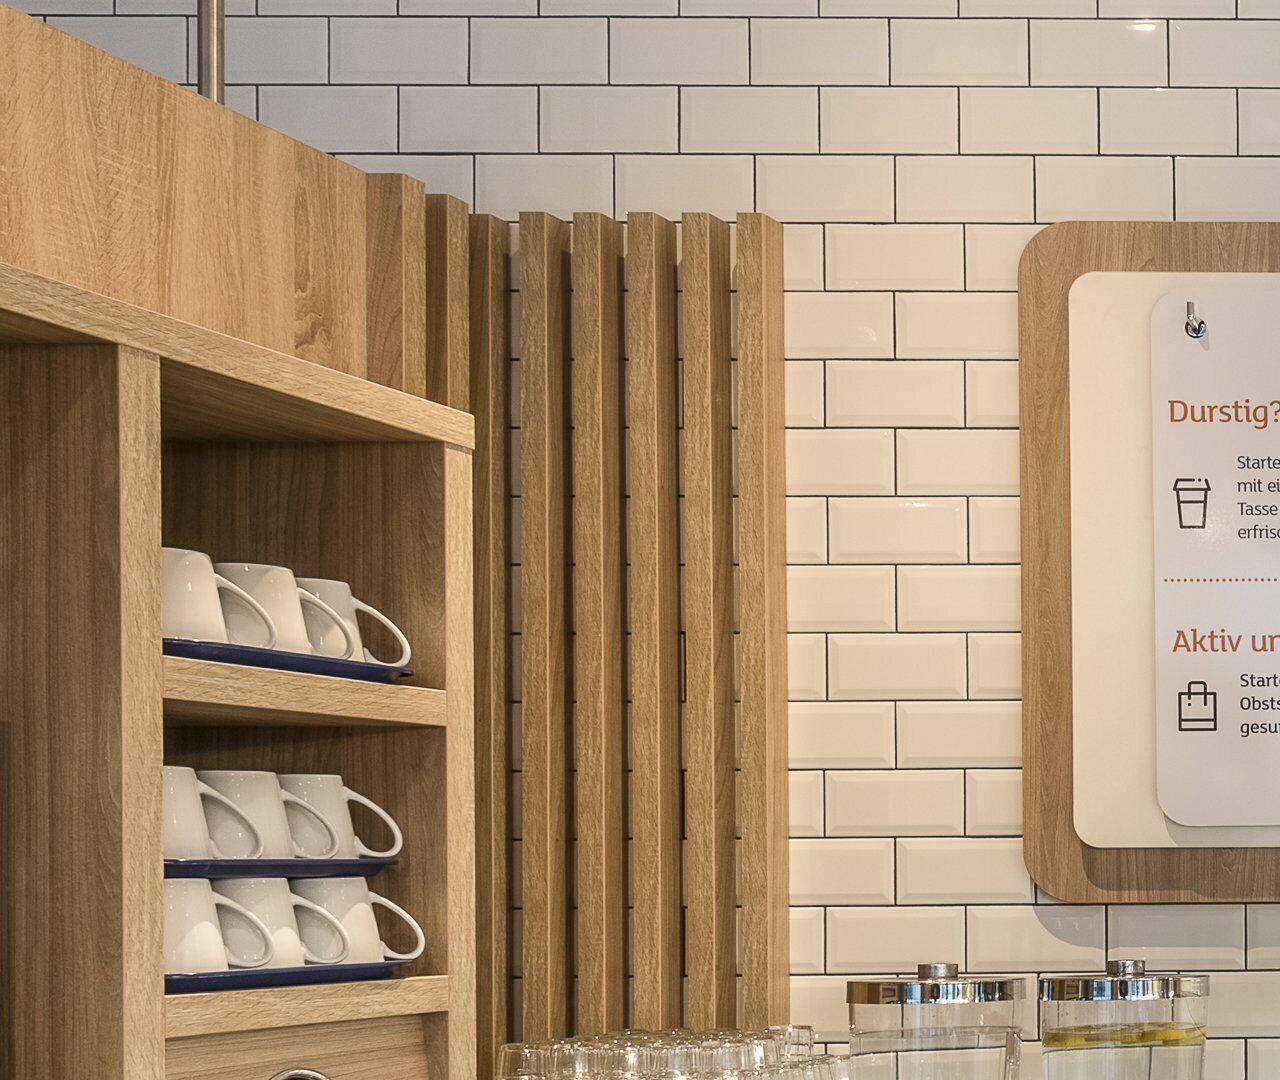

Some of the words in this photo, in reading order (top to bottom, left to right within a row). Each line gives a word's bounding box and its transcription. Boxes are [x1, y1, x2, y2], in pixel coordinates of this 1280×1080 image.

[1236, 477, 1264, 493] mit
[1236, 502, 1279, 516] Tasse
[1172, 628, 1243, 653] Aktiv
